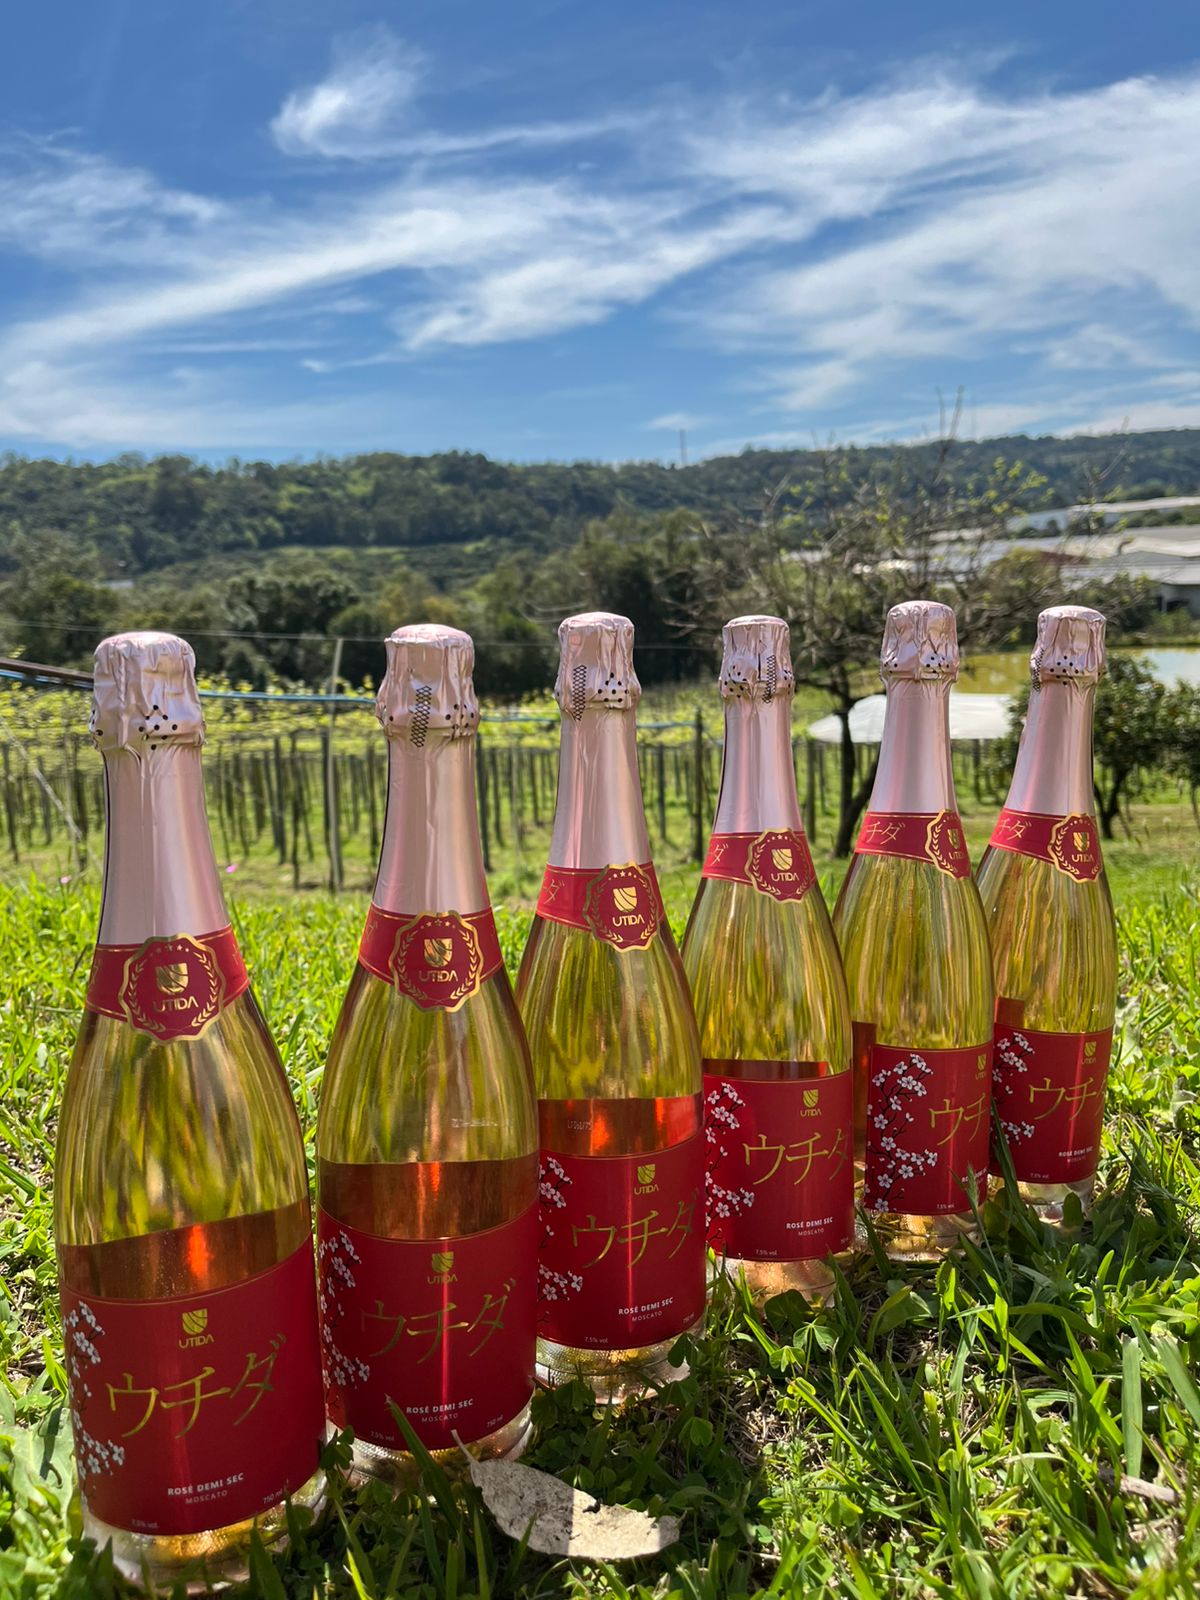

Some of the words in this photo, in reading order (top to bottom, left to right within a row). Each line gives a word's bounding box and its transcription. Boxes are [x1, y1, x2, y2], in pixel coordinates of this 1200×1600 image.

[866, 821, 906, 844] チダ
[1071, 854, 1094, 863] UTIDA
[771, 872, 800, 883] UTIDA
[612, 913, 645, 927] UTIDA
[419, 970, 459, 983] UTIDA
[152, 995, 199, 1013] UTIDA
[800, 1108, 822, 1117] UTIDA
[634, 1184, 659, 1195] UTIDA
[786, 1220, 804, 1230] ROSÉ
[805, 1218, 822, 1229] DEMI
[823, 1216, 833, 1225] SEC
[798, 1227, 825, 1237] MOSCATO
[427, 1275, 457, 1285] UTIDA
[618, 1306, 639, 1315] ROSÉ
[641, 1302, 660, 1313] DEMI
[661, 1296, 674, 1308] SEC
[360, 1277, 517, 1364] ウチダ
[632, 1310, 663, 1322] MOSCATO
[178, 1333, 214, 1349] UTIDA
[105, 1332, 287, 1440] ウチダ
[406, 1405, 429, 1414] ROSÉ
[432, 1401, 456, 1413] DEMI
[458, 1398, 474, 1409] SEC
[421, 1412, 459, 1423] MOSCATO
[167, 1484, 194, 1496] ROSÉ
[197, 1479, 224, 1492] DEMI
[226, 1472, 245, 1486] SEC
[185, 1489, 228, 1504] MOSCATO
